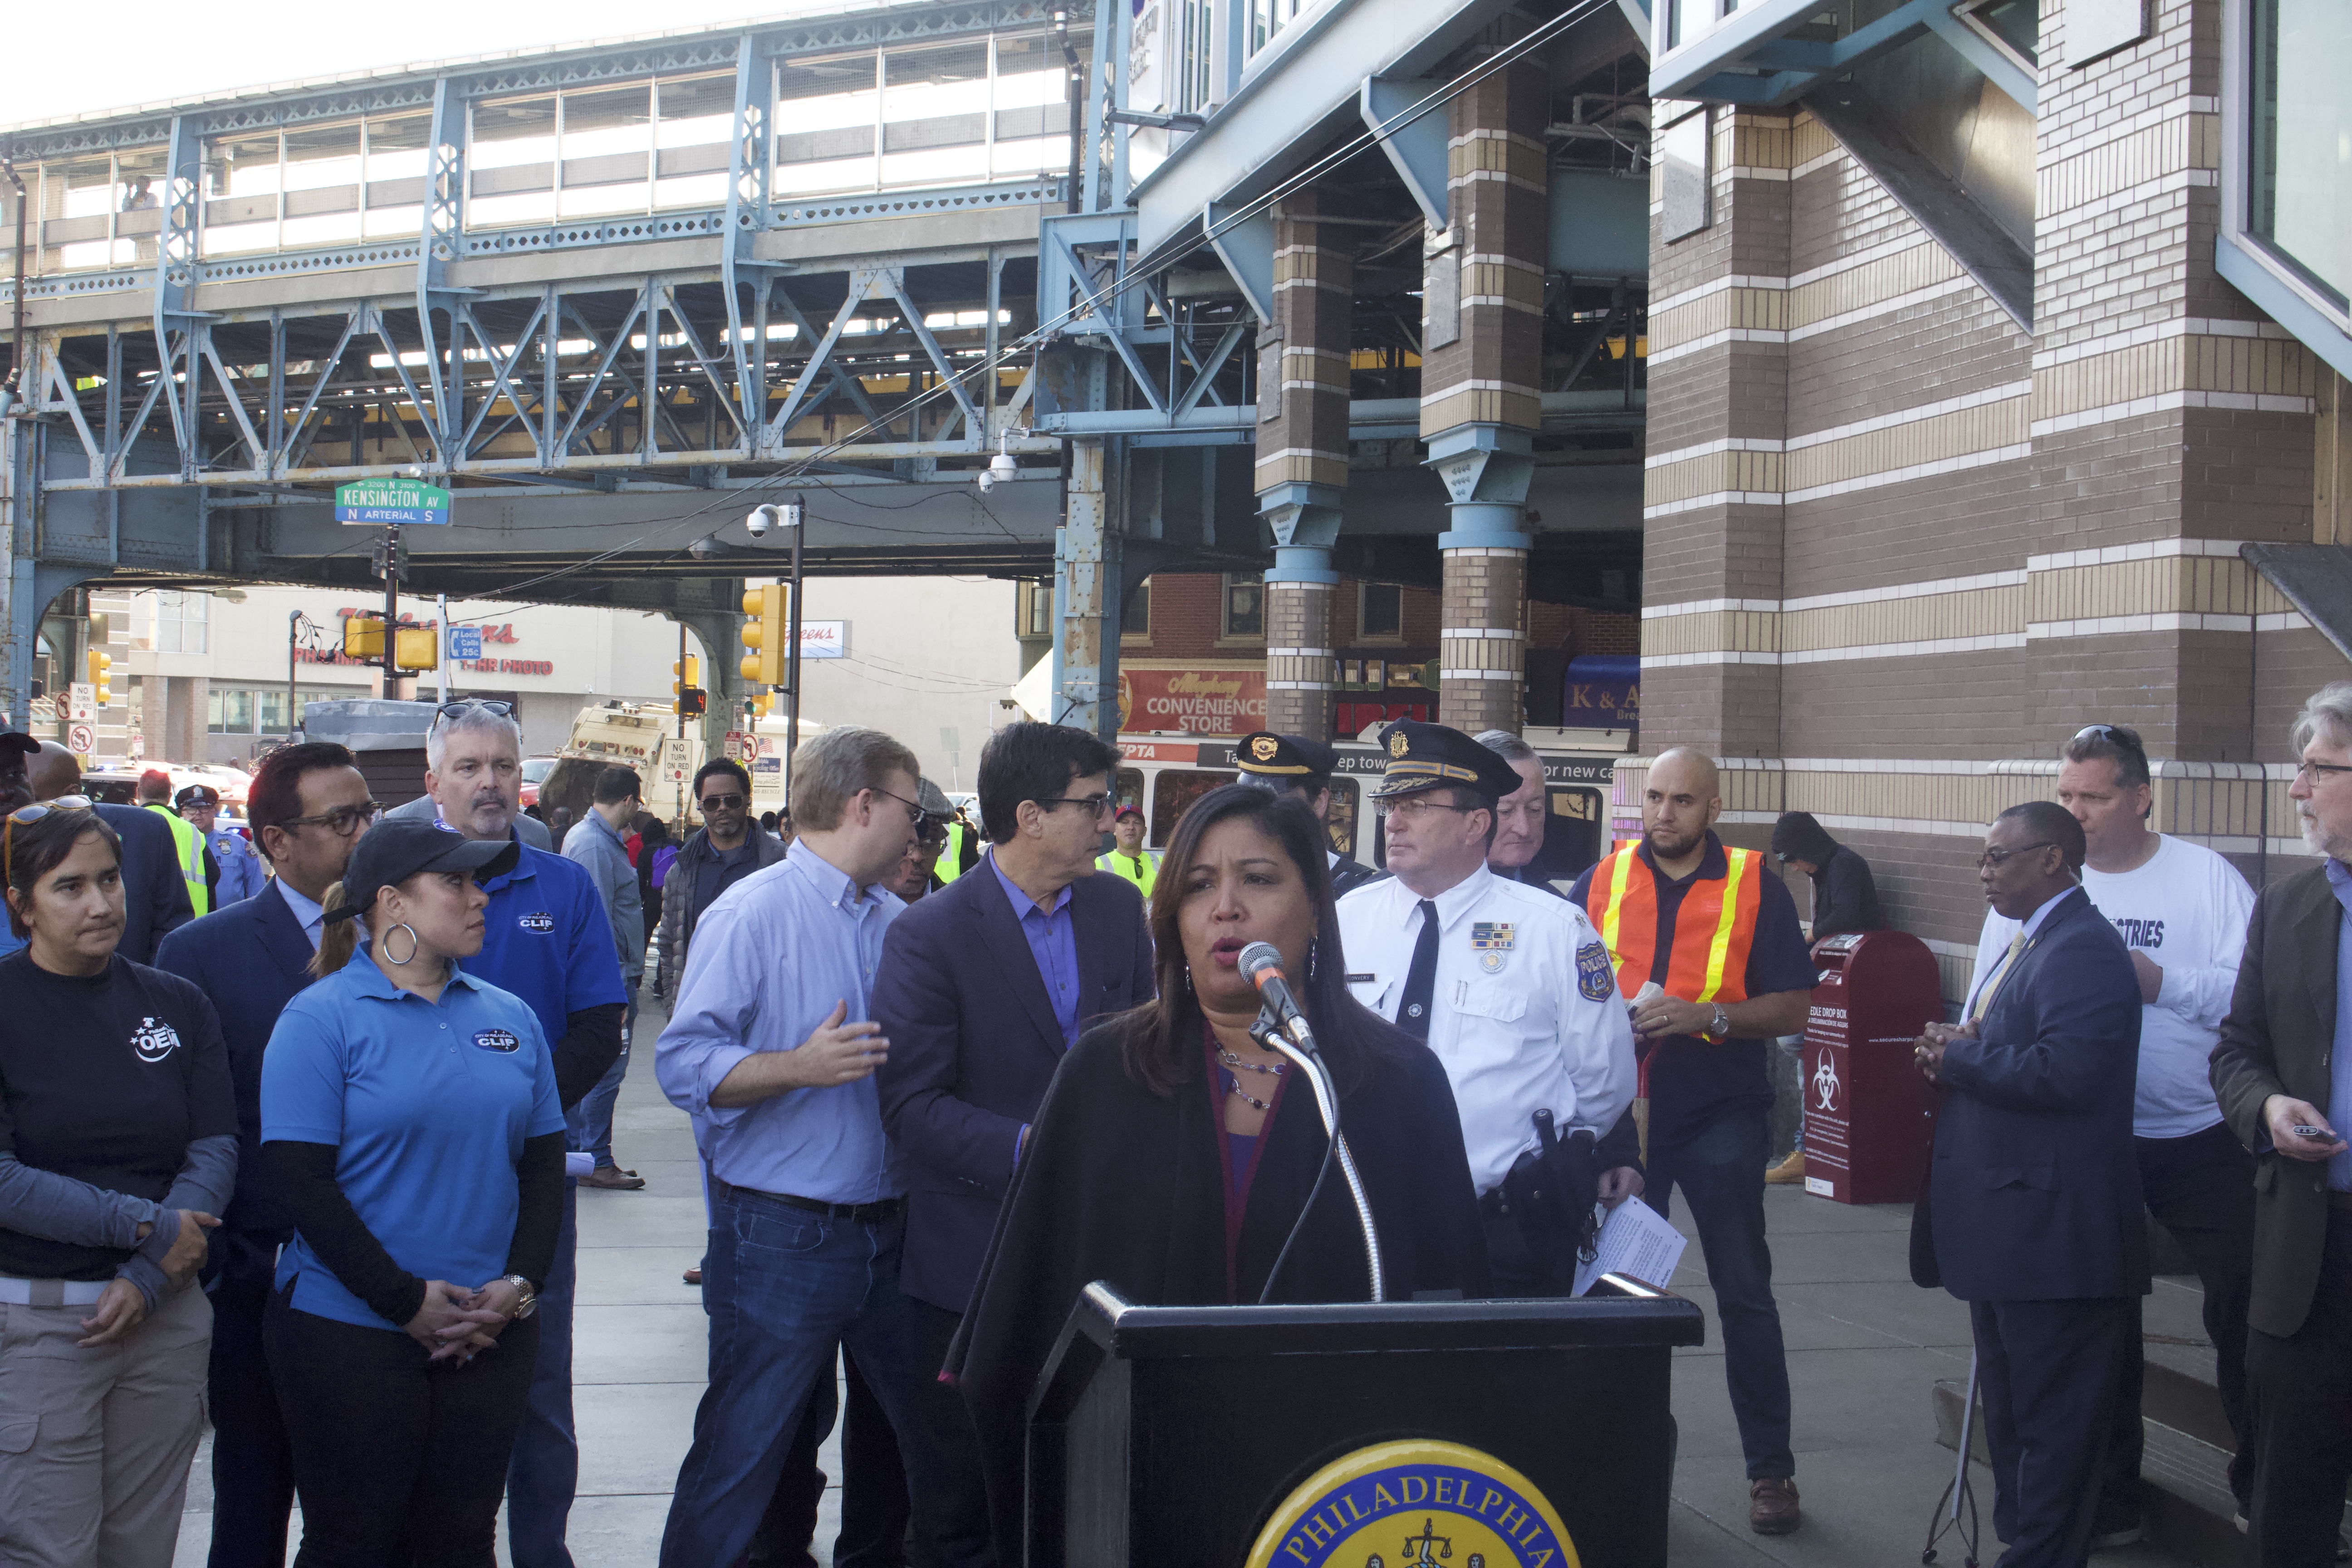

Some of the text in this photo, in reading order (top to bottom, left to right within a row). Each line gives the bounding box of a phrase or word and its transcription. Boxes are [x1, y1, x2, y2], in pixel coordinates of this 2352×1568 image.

[389, 481, 395, 489] N
[343, 489, 439, 507] KENSINGTON AV
[348, 509, 433, 522] N ARTERIAL S
[501, 659, 554, 675] PHOTO
[1571, 684, 1640, 709] K & A
[1147, 697, 1266, 716] CONVENIENCE
[1179, 715, 1233, 732] STORE
[1563, 766, 1596, 778] new
[519, 919, 553, 928] CLIP
[1580, 954, 1607, 975] POLICE
[1822, 1007, 1836, 1018] DROP
[1837, 1009, 1847, 1019] BOX
[140, 1030, 181, 1051] OEM
[478, 1038, 515, 1046] CLIP
[1283, 1475, 1555, 1568] PHILADELPHIA
